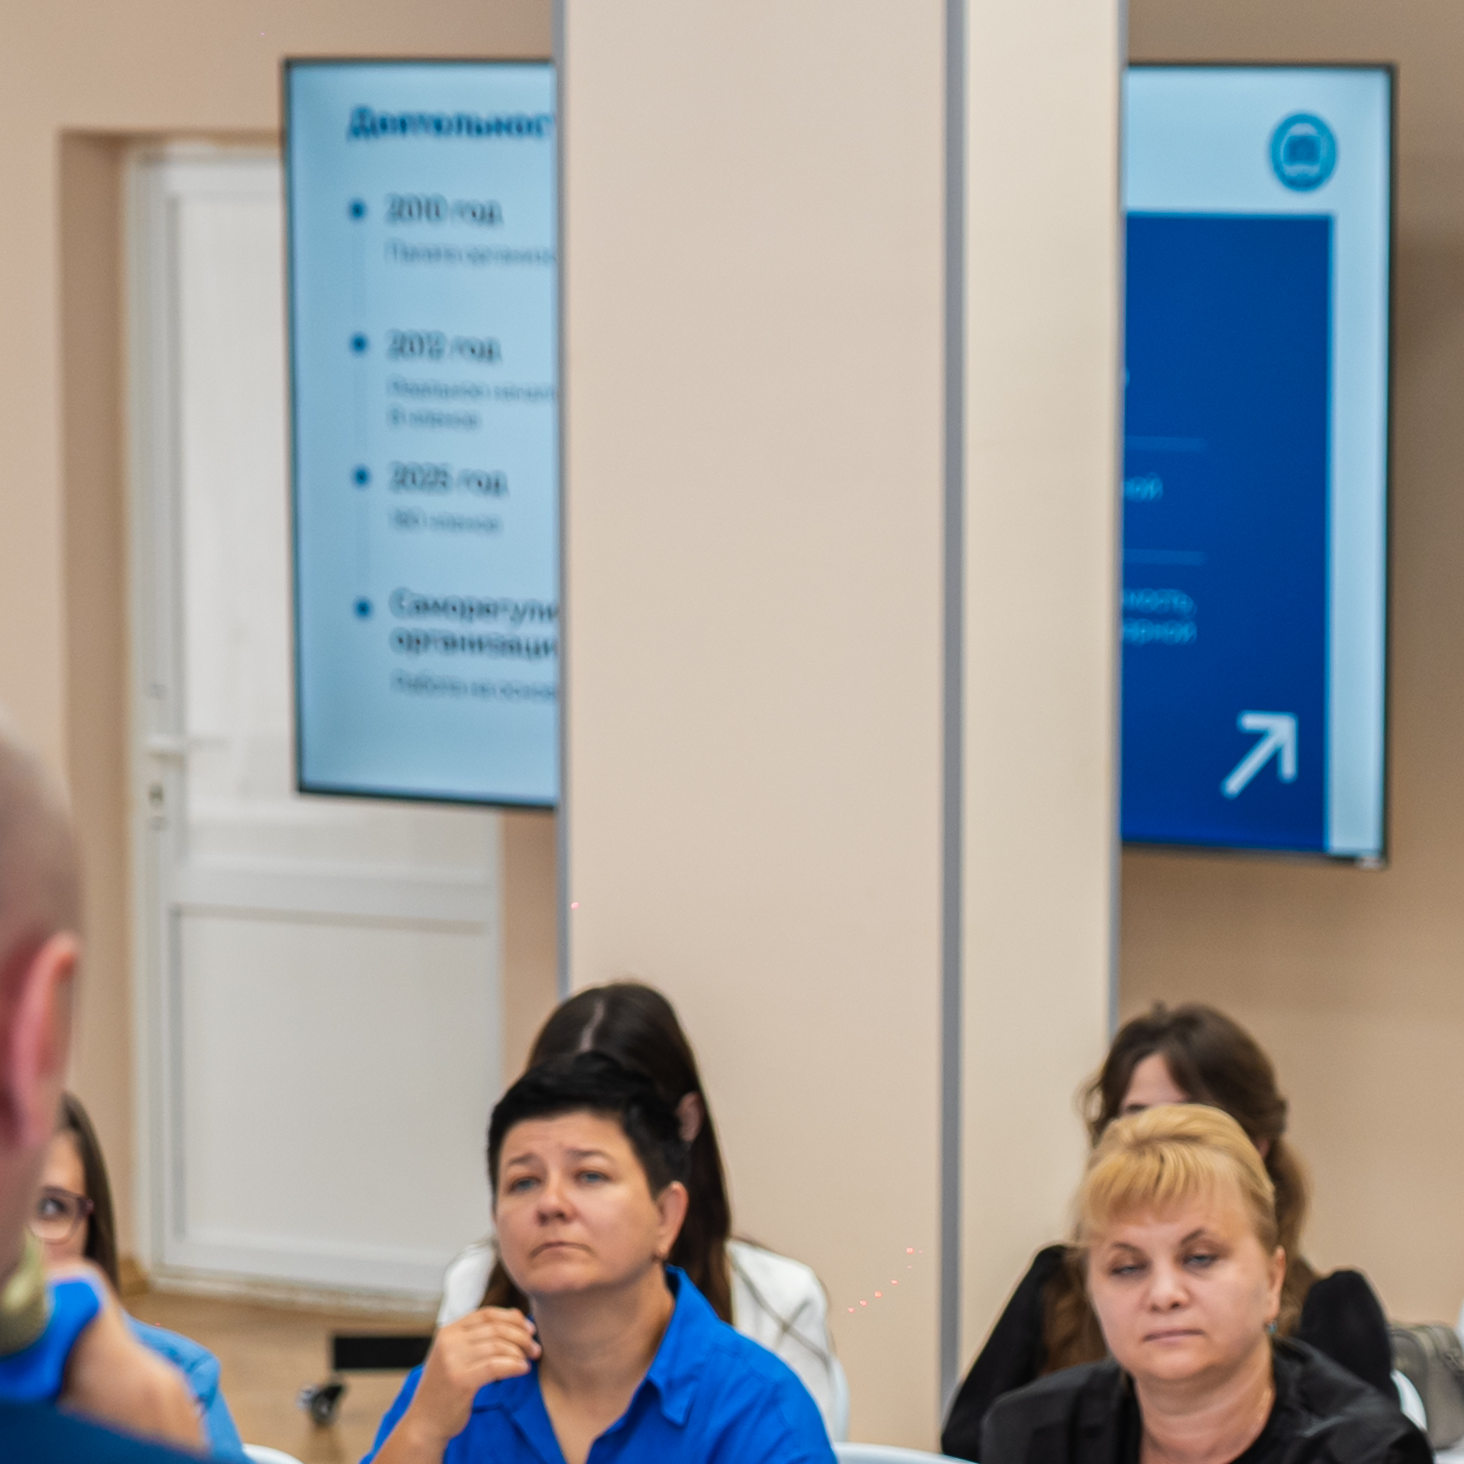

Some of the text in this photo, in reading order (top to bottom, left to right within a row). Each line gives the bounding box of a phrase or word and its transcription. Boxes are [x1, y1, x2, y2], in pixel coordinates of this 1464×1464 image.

[385, 194, 503, 229] 2010 год
[386, 329, 502, 366] 2012 год
[387, 463, 509, 500] 2025 год
